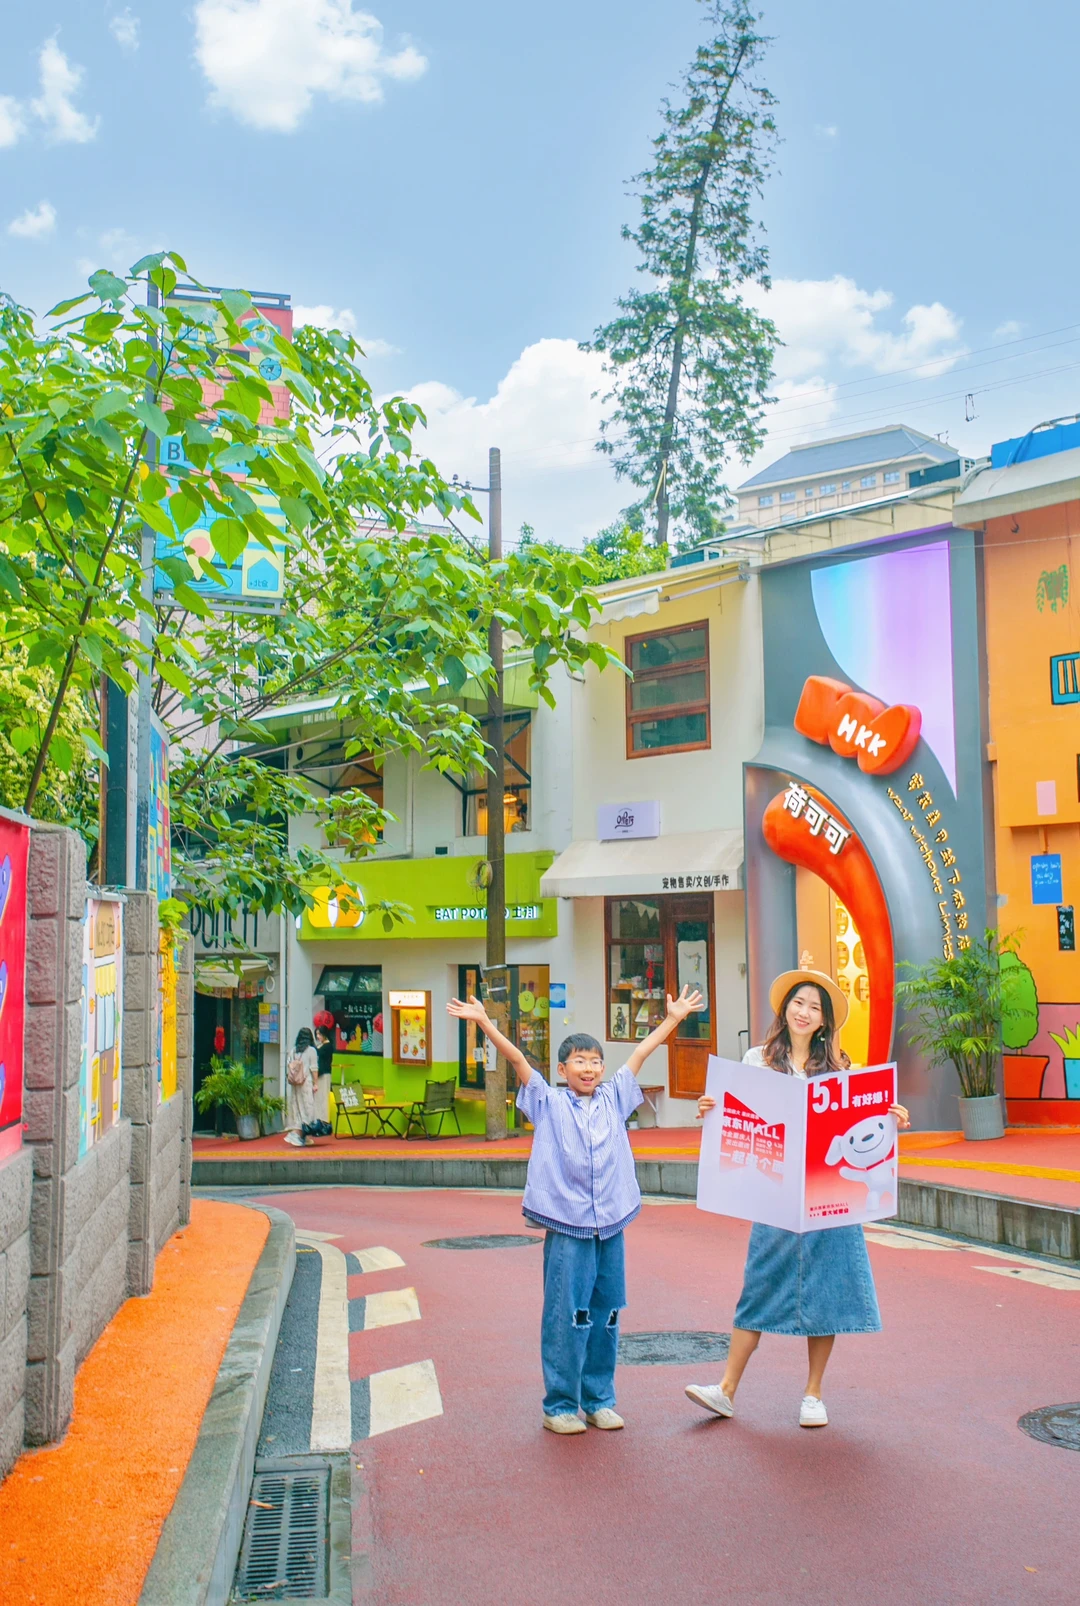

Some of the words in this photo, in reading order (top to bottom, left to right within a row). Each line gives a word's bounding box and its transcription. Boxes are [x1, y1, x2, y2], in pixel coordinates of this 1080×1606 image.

[837, 713, 886, 757] HKK
[783, 781, 852, 855] 荷可可
[887, 787, 914, 821] wear
[910, 825, 943, 895] without
[435, 907, 459, 921] EAT
[812, 1076, 849, 1114] 5.1
